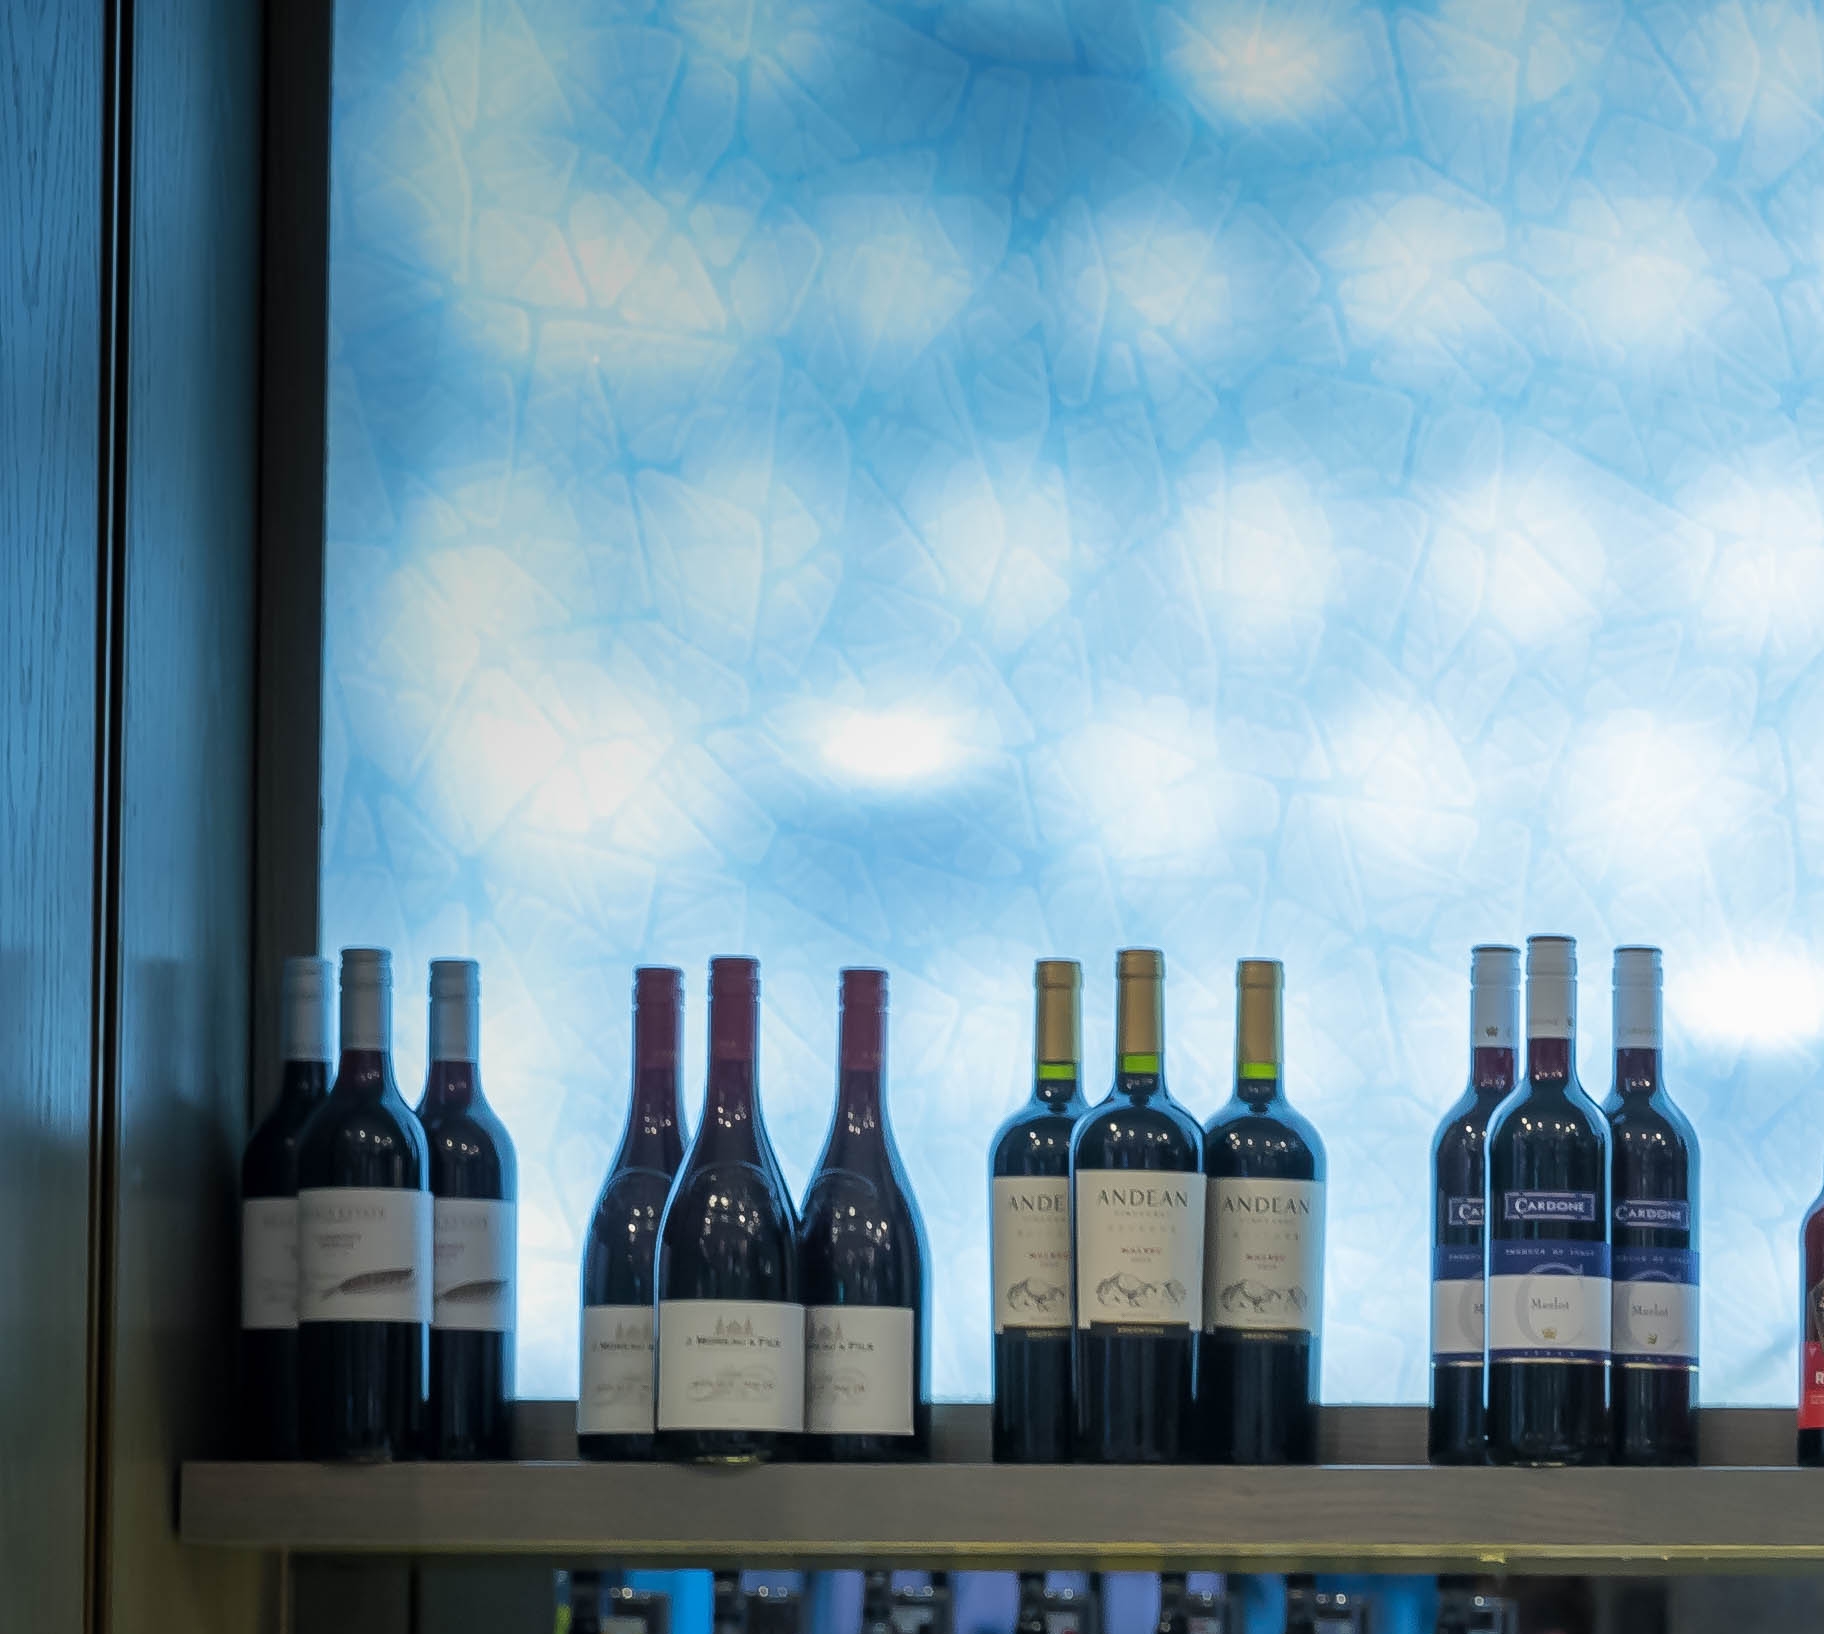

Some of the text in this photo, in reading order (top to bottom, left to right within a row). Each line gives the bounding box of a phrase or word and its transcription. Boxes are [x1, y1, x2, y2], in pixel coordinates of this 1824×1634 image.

[1008, 1194, 1070, 1212] ANDE
[1099, 1189, 1188, 1209] ANDEAN
[1223, 1196, 1311, 1215] ANDEAN
[1514, 1198, 1585, 1214] CARDONE
[1530, 1298, 1570, 1311] Merlot
